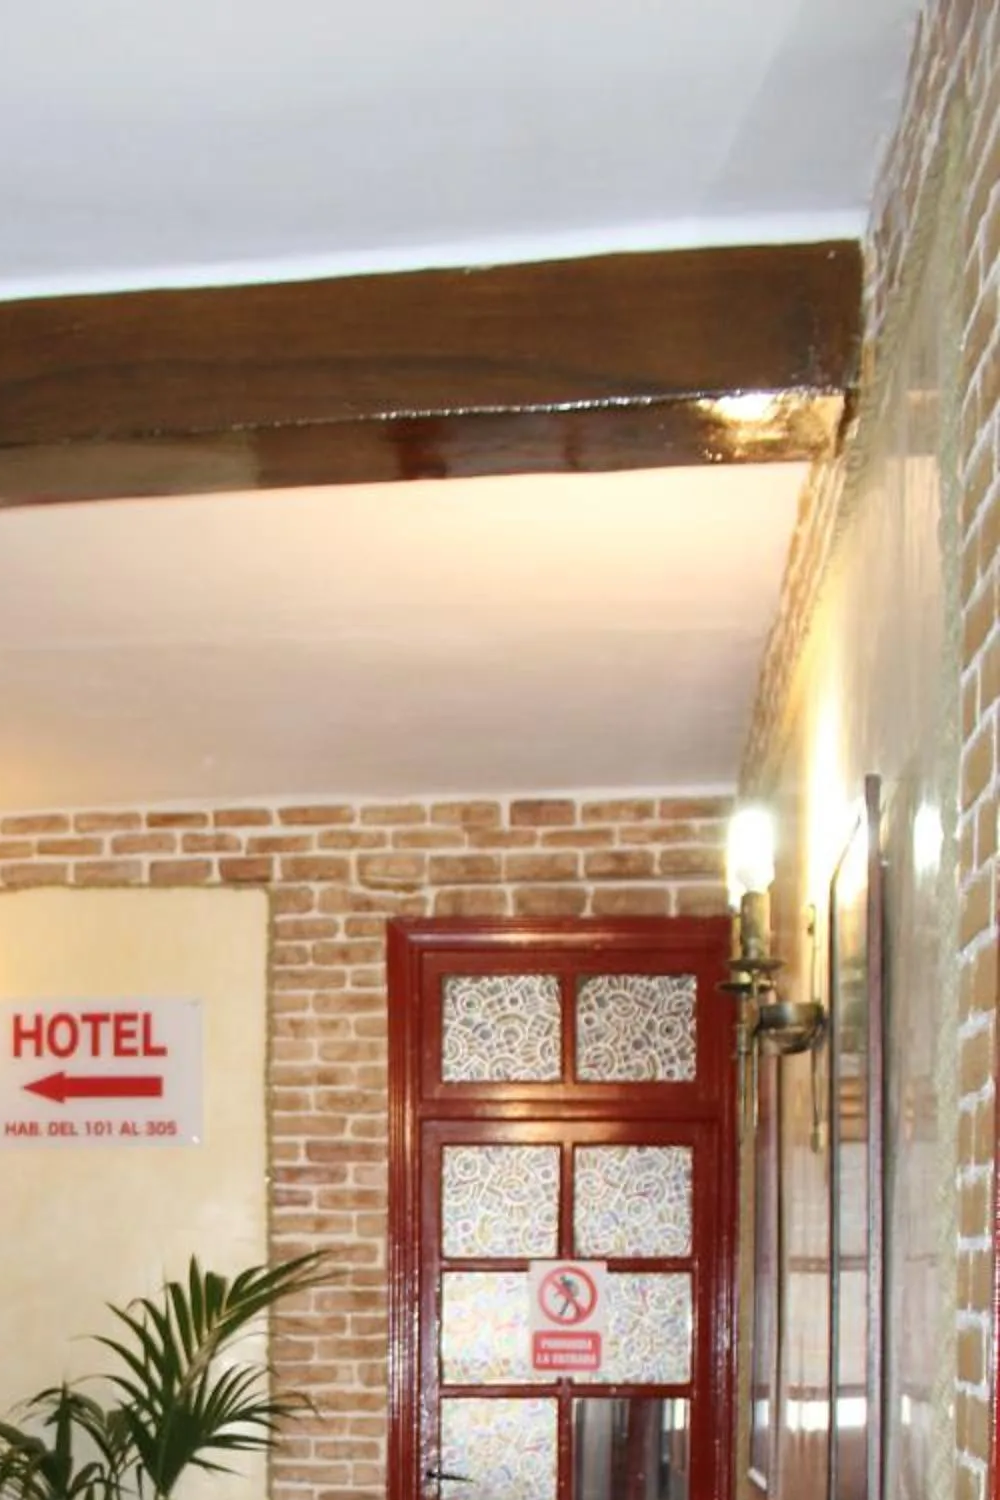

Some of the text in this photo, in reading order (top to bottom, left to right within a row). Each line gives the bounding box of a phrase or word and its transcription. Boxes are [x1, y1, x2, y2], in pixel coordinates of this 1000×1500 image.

[12, 1012, 168, 1058] HOTEL
[48, 1120, 79, 1136] DEL
[85, 1120, 112, 1136] 101
[120, 1120, 140, 1136] AL
[146, 1120, 177, 1136] 305
